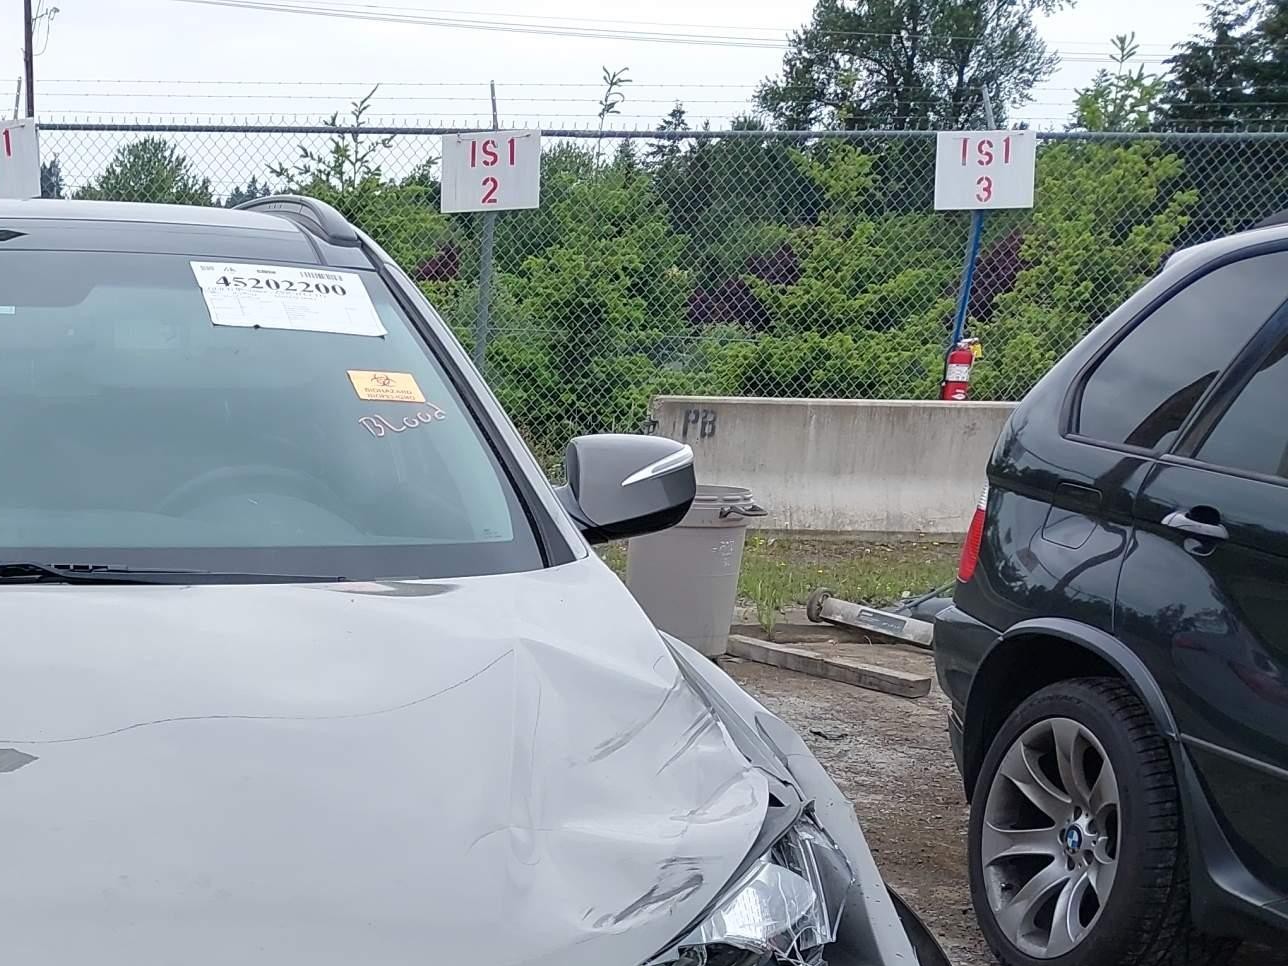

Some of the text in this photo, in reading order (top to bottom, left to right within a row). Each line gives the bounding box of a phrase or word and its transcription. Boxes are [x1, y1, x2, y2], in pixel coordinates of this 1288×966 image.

[470, 138, 515, 168] IS1
[961, 136, 1010, 166] IS1
[481, 176, 498, 204] 2
[976, 176, 993, 203] 3
[215, 275, 347, 296] 45202200
[682, 409, 717, 438] PB
